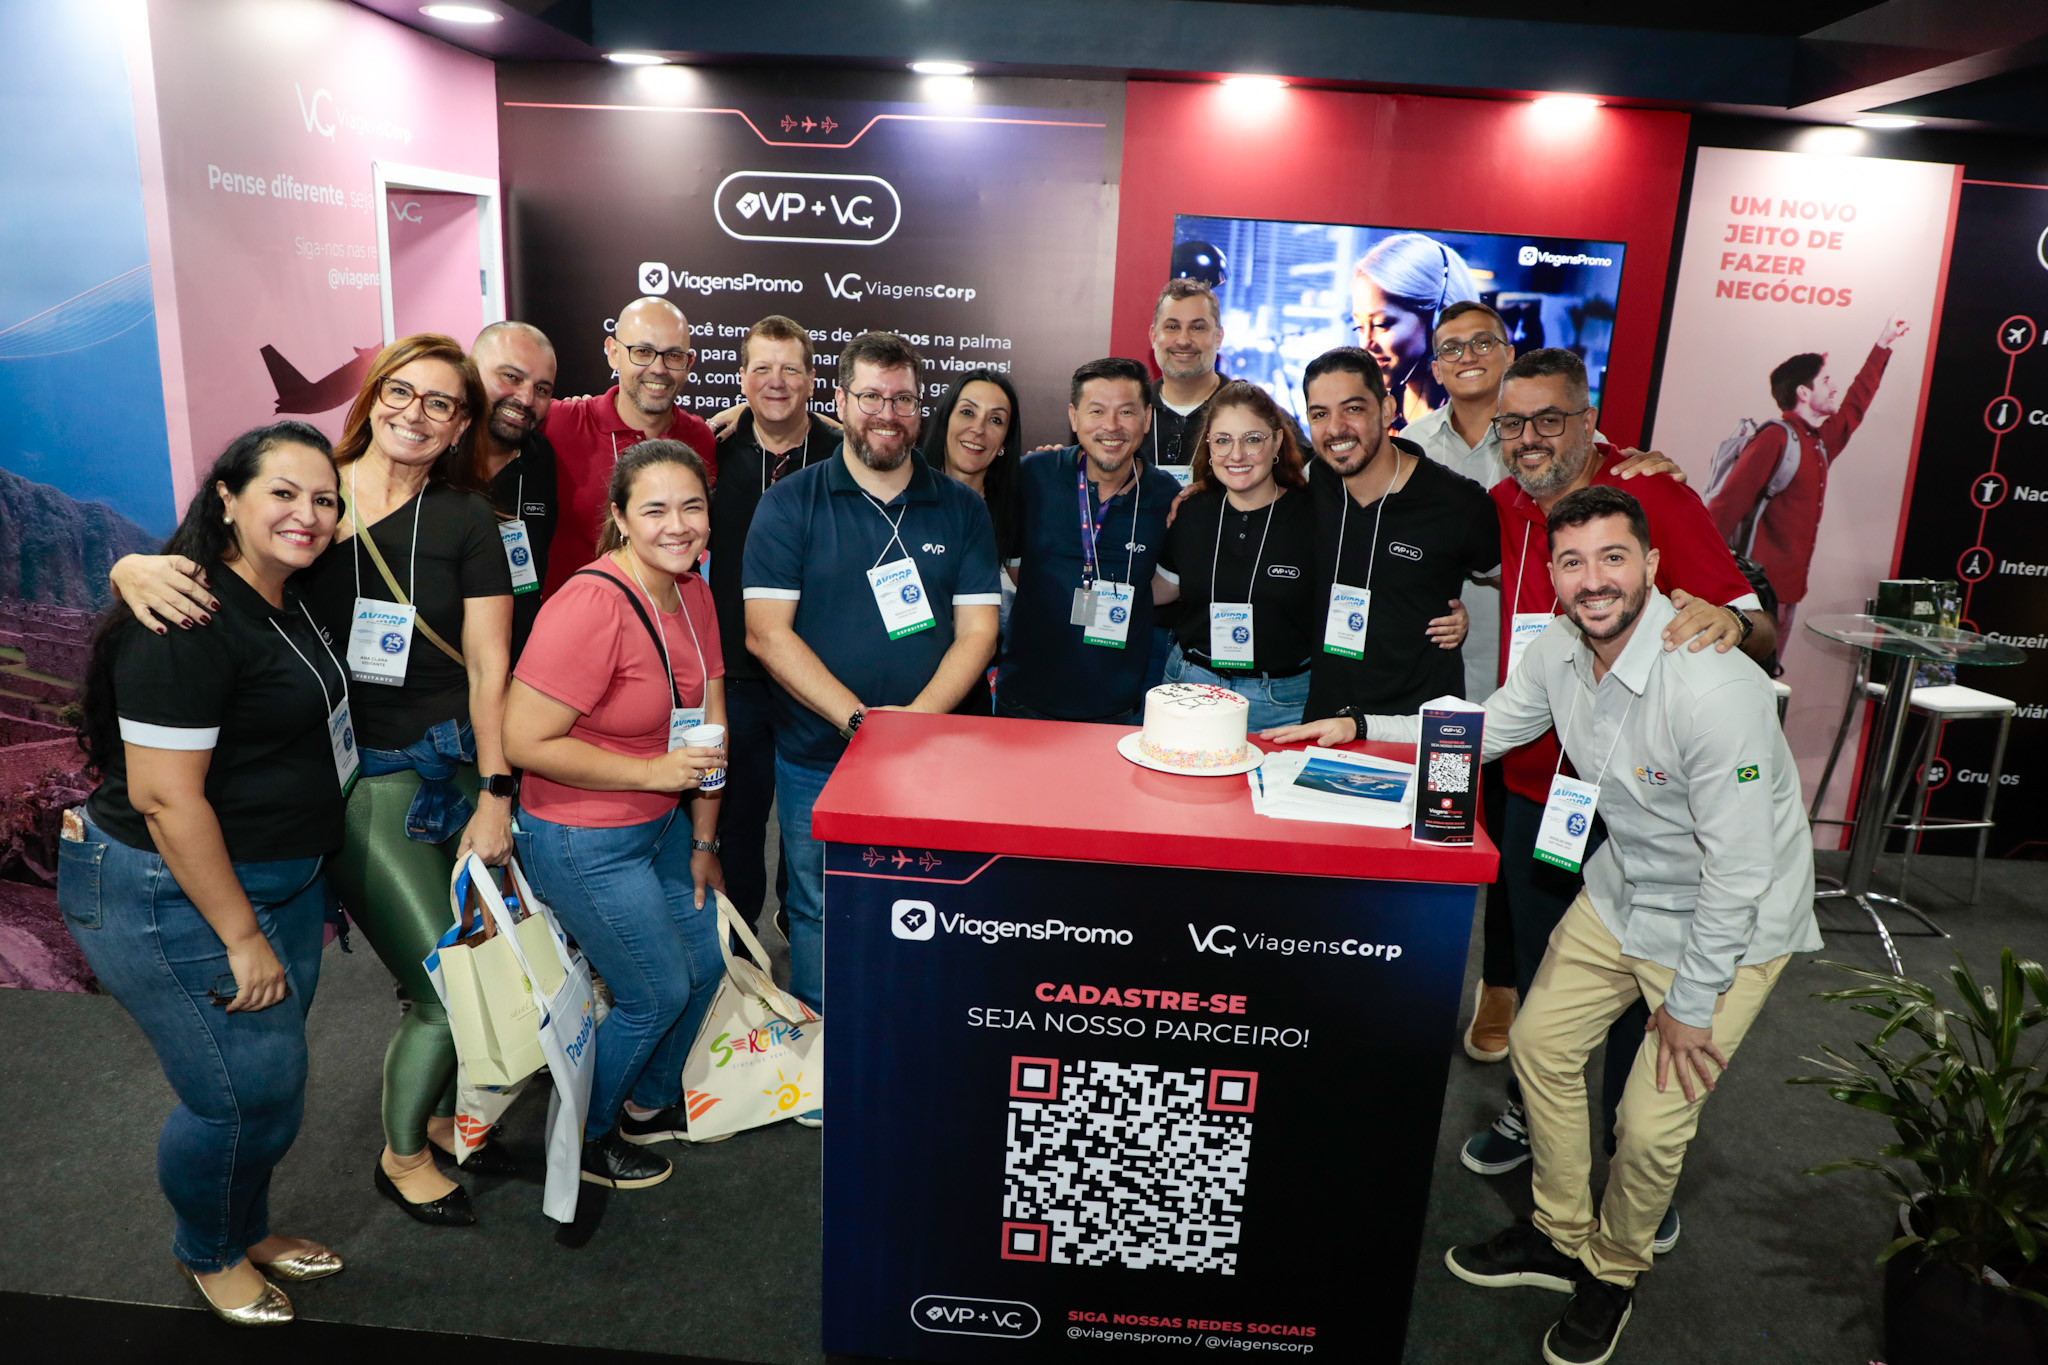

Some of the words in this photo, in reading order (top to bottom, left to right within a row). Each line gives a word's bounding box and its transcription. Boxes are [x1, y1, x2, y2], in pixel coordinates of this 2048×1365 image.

[208, 164, 266, 196] Pense
[271, 173, 347, 210] diferente,
[1730, 195, 1772, 217] UM
[1779, 199, 1857, 223] NOVO
[295, 236, 345, 260] Siga-nos
[347, 244, 366, 258] nas
[1724, 224, 1800, 247] JEITO
[1807, 230, 1844, 250] DE
[1538, 251, 1612, 267] ViagensPromo
[1720, 252, 1806, 276] FAZER
[671, 270, 803, 296] ViagensPromo
[865, 281, 976, 302] ViagensCorp
[1715, 278, 1853, 307] NEGÓCIOS
[688, 321, 714, 336] ocê
[831, 327, 853, 342] de
[934, 335, 954, 347] na
[959, 333, 1012, 350] palma
[701, 348, 737, 363] para
[695, 395, 731, 409] para
[355, 673, 393, 683] VISITANTE
[1957, 769, 2020, 787] Gruos
[939, 911, 1133, 946] ViagensPromo
[1242, 932, 1403, 961] ViagensCorp
[1034, 981, 1247, 1014] CADASTRE-SE
[966, 1006, 1036, 1031] SEJA
[1044, 1012, 1147, 1038] NOSSO
[1154, 1019, 1310, 1048] PARCEIRO!
[1067, 1310, 1108, 1323] SIGA
[1113, 1313, 1182, 1329] NOSSAS
[1187, 1318, 1242, 1332] REDES
[1247, 1323, 1317, 1337] SOCIAIS
[1066, 1326, 1192, 1345] @viagenspromo
[1195, 1334, 1203, 1347] /
[1204, 1336, 1314, 1354] @viagenscorp
